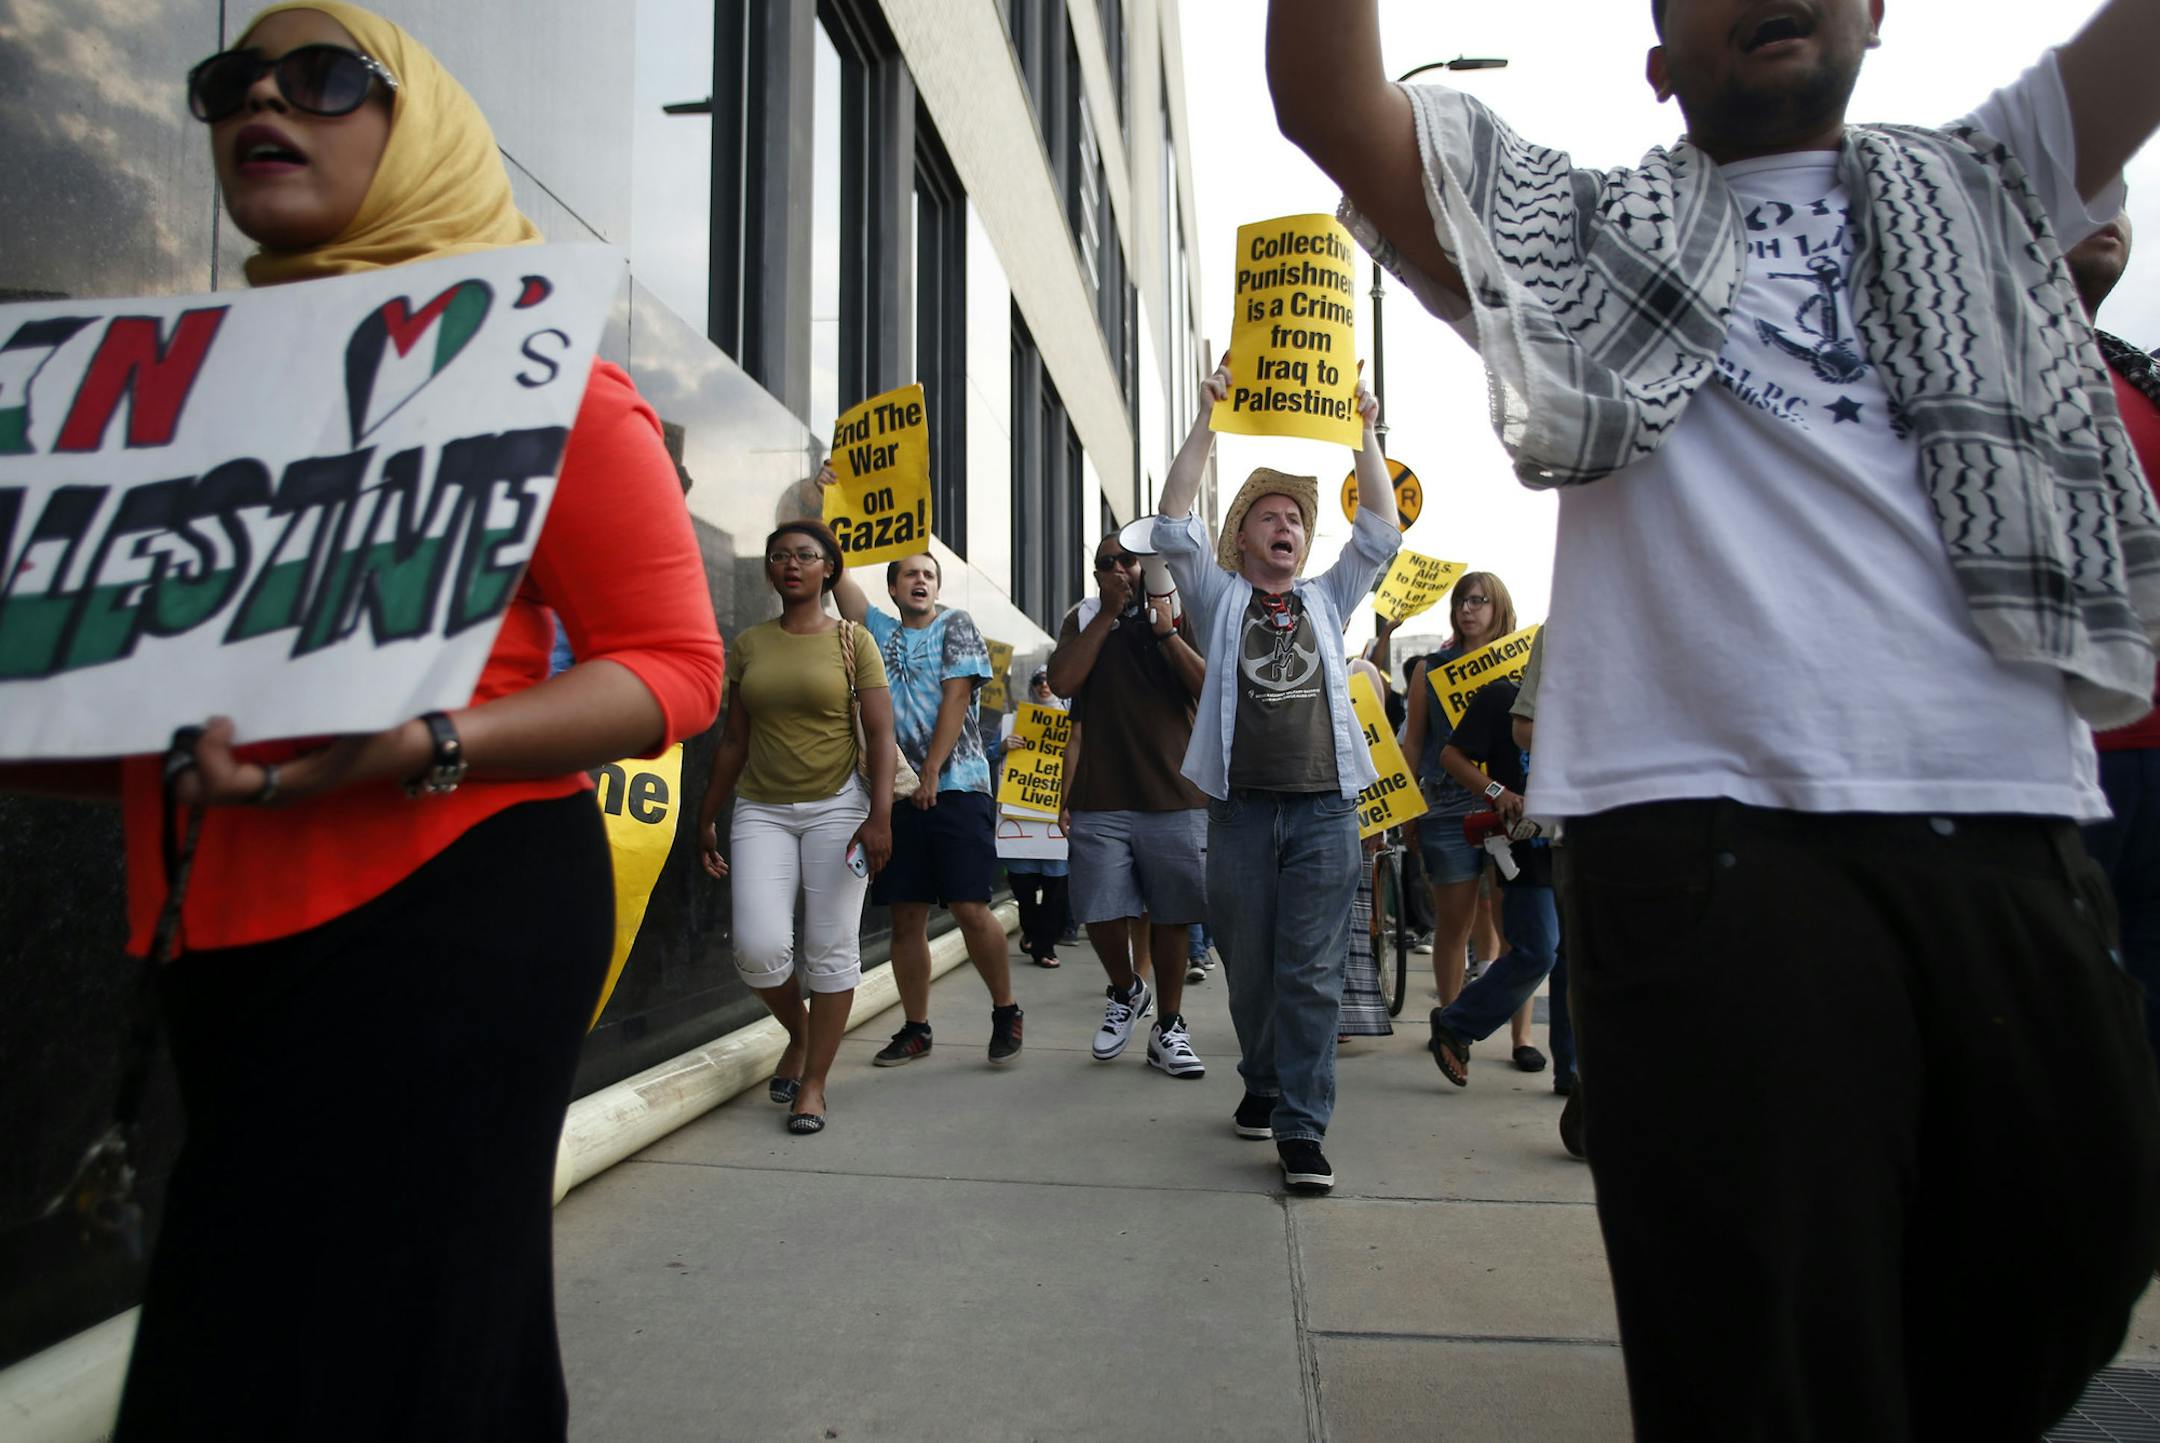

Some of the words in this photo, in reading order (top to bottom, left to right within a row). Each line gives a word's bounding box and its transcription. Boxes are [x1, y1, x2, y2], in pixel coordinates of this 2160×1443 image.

[1248, 298, 1265, 322] is
[1270, 299, 1283, 318] a
[1291, 292, 1353, 328] Crime
[1271, 325, 1331, 353] from
[1257, 356, 1308, 387] Iraq
[1317, 362, 1338, 386] to
[1233, 387, 1352, 422] Palestine!
[832, 411, 870, 448] End
[874, 402, 922, 435] The
[849, 442, 899, 477] War
[863, 487, 895, 515] on
[1401, 488, 1416, 507] R
[829, 498, 925, 553] Gaza!
[1409, 555, 1427, 567] No
[1396, 572, 1409, 584] to
[1415, 569, 1438, 581] Aid
[1406, 590, 1426, 602] Let
[1031, 709, 1053, 726] No
[1042, 727, 1068, 743] Aid
[1035, 759, 1060, 776] Let
[1021, 787, 1059, 808] Live!
